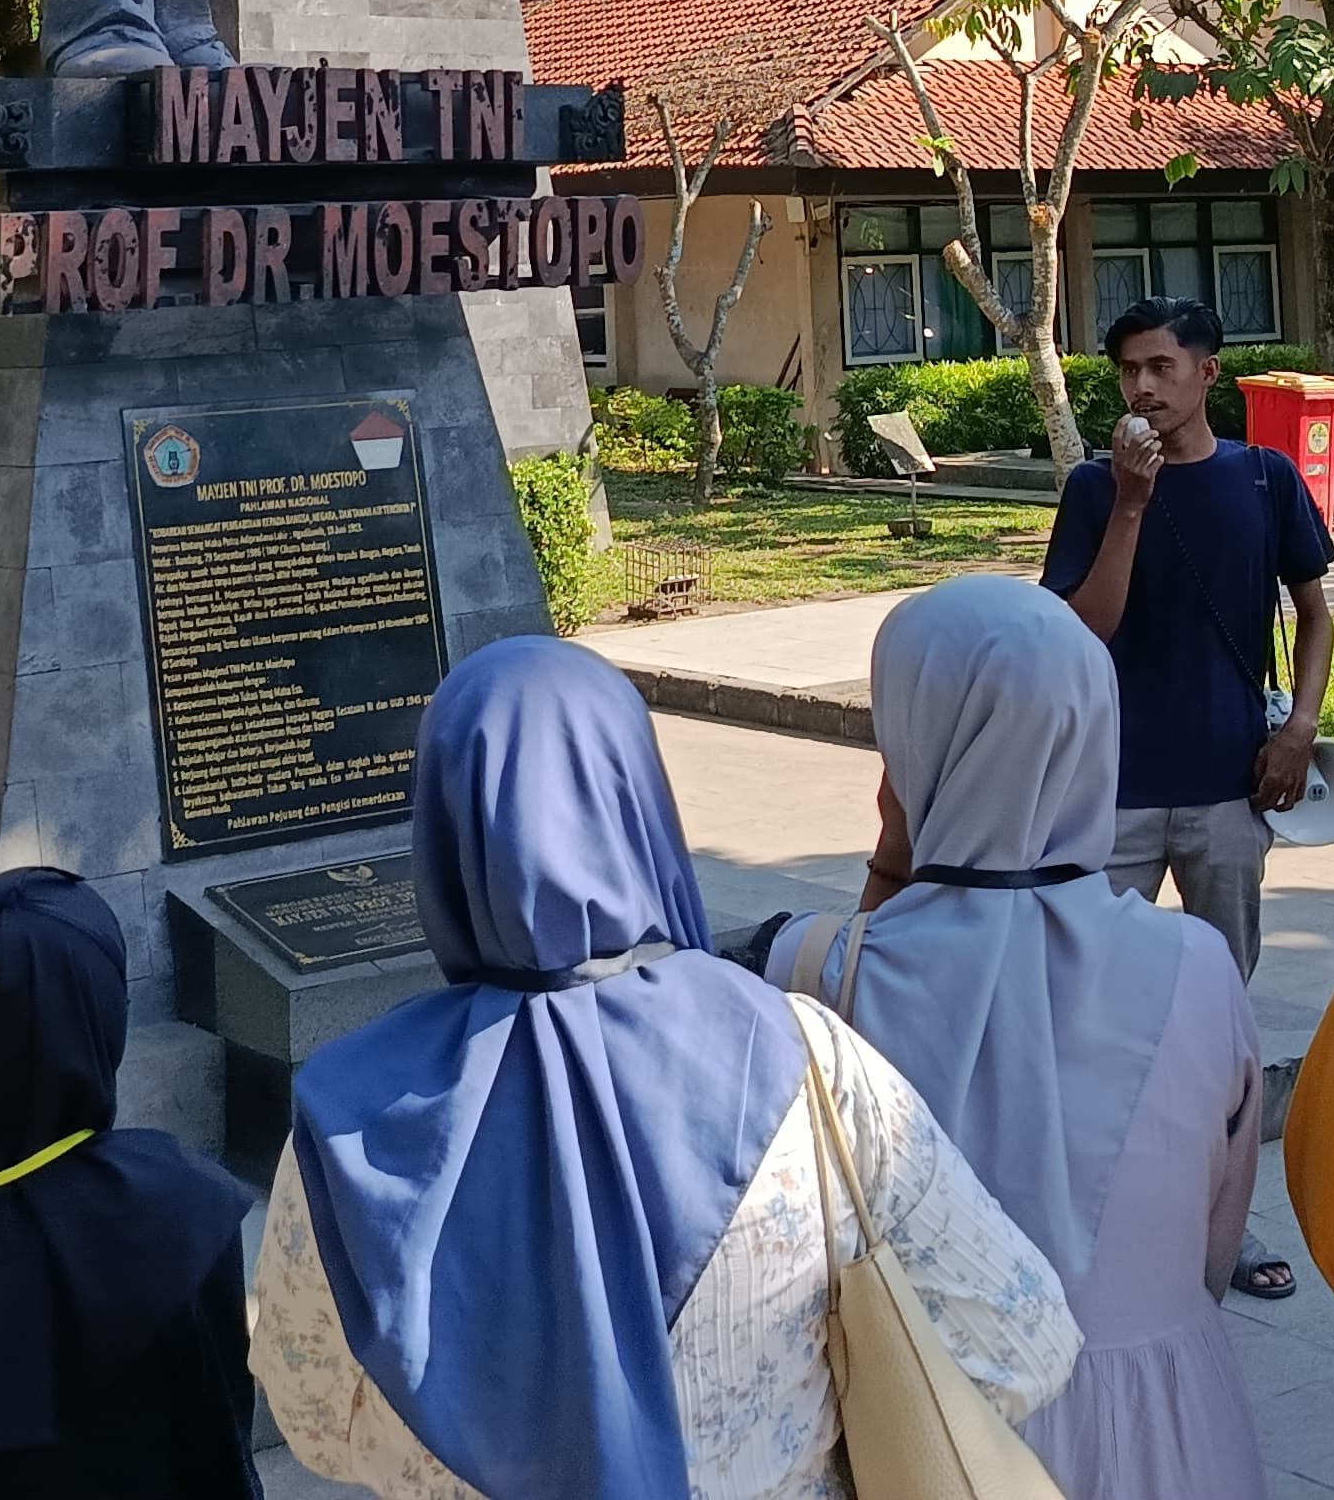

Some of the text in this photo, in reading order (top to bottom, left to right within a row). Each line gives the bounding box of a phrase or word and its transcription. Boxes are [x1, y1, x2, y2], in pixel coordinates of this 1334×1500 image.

[161, 67, 524, 163] MAYJEN TNI
[209, 205, 315, 306] DR.
[323, 195, 645, 299] MOESTOPO
[196, 470, 366, 501] MAYJEN TNI PROF. DR. MOESTOPO
[239, 495, 330, 512] PAHLAWAN NASIONAL
[303, 805, 320, 816] dan
